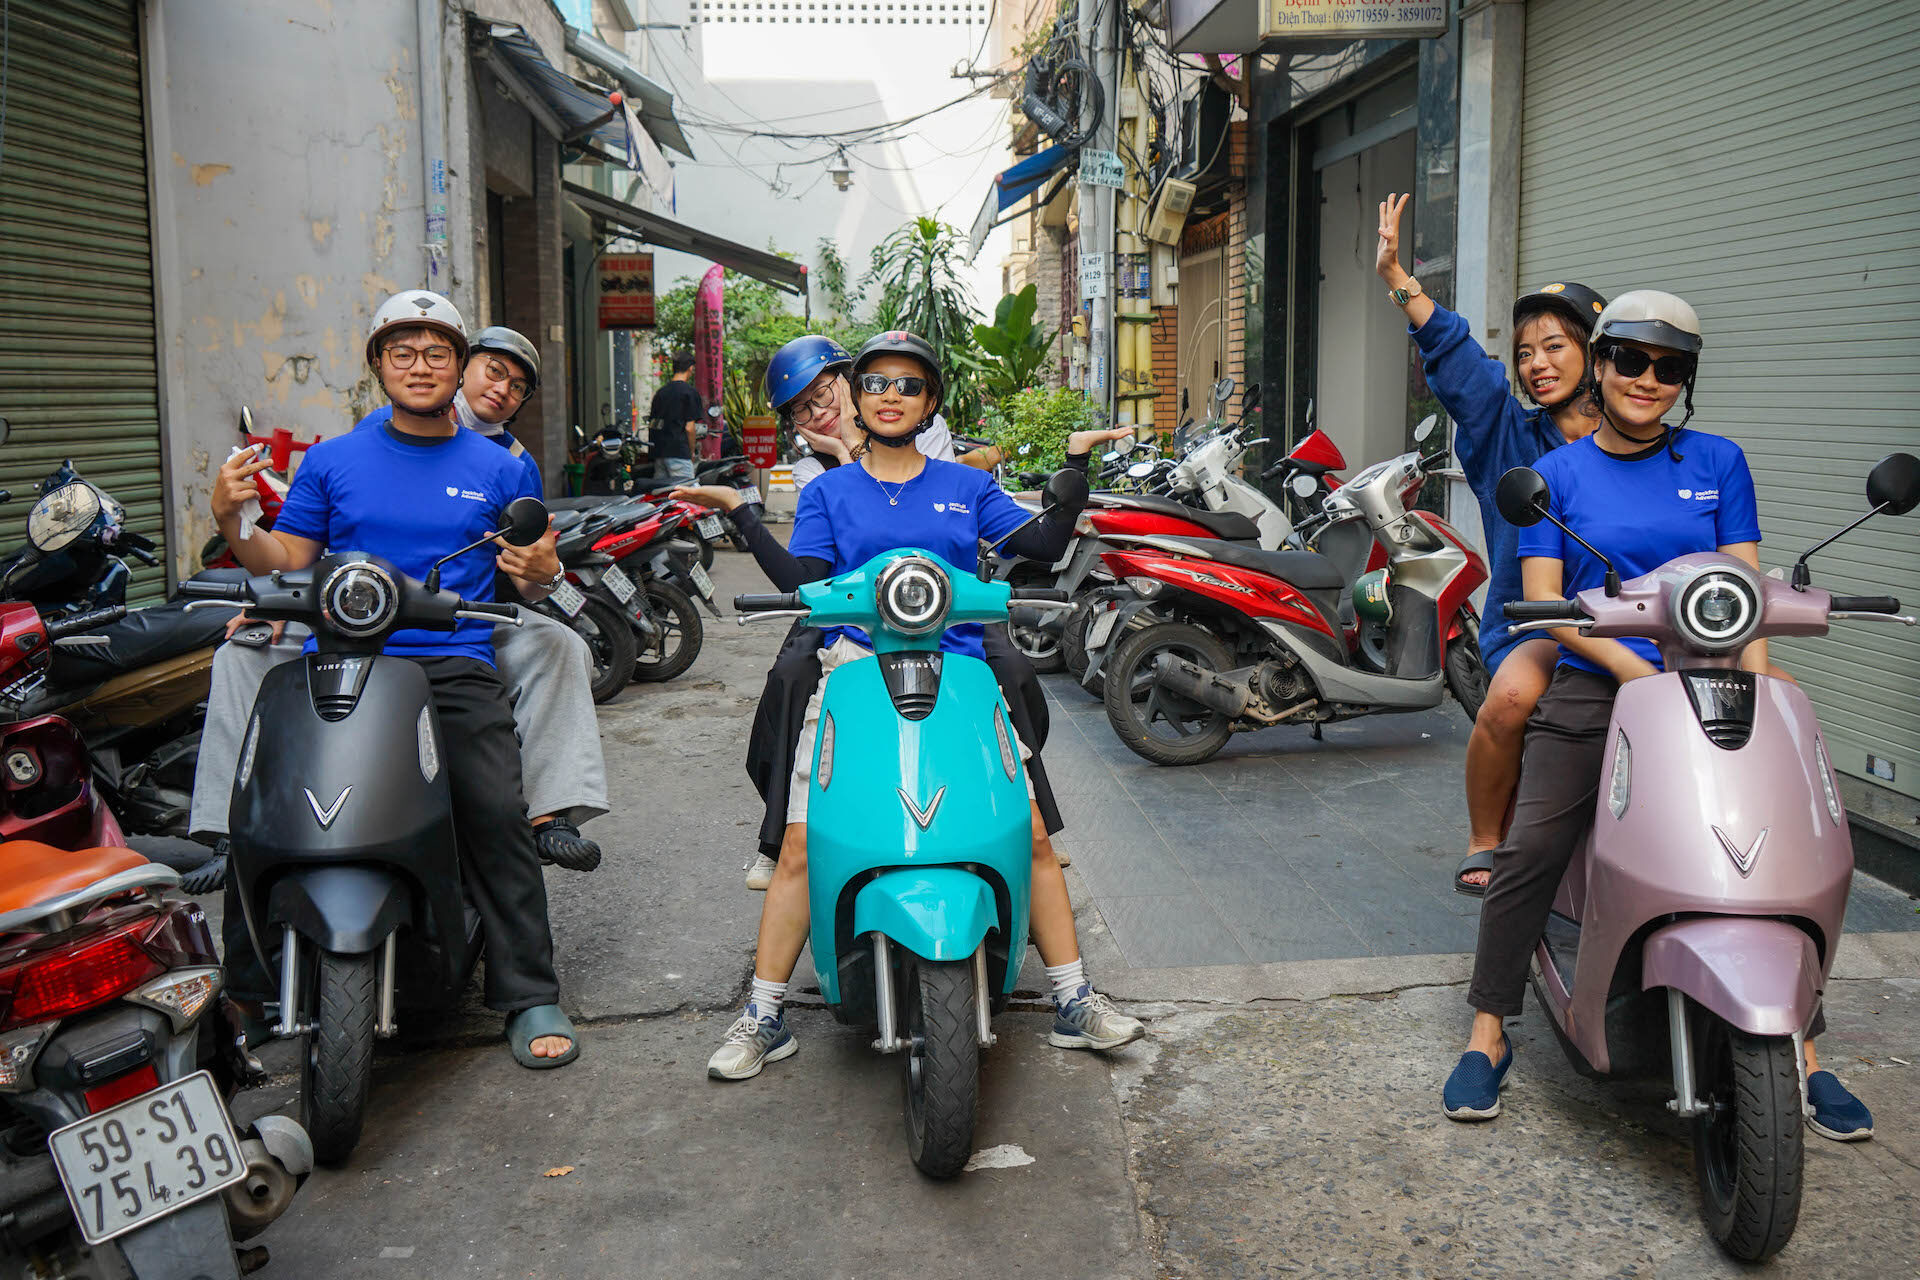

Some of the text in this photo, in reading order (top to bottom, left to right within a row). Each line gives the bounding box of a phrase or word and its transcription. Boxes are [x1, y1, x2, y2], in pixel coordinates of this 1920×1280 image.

[1278, 11, 1300, 28] Điện
[1301, 10, 1327, 26] Thoại
[1333, 8, 1389, 23] 0939719559
[1397, 7, 1442, 21] 38591072
[743, 435, 758, 444] CHO
[747, 445, 757, 454] XE
[1172, 567, 1257, 594] VISION
[316, 663, 362, 671] VINFAST
[890, 662, 935, 671] VINFAST
[1695, 682, 1748, 691] VINFAST
[77, 1090, 197, 1173] 59-S1
[80, 1133, 234, 1233] 754.39
